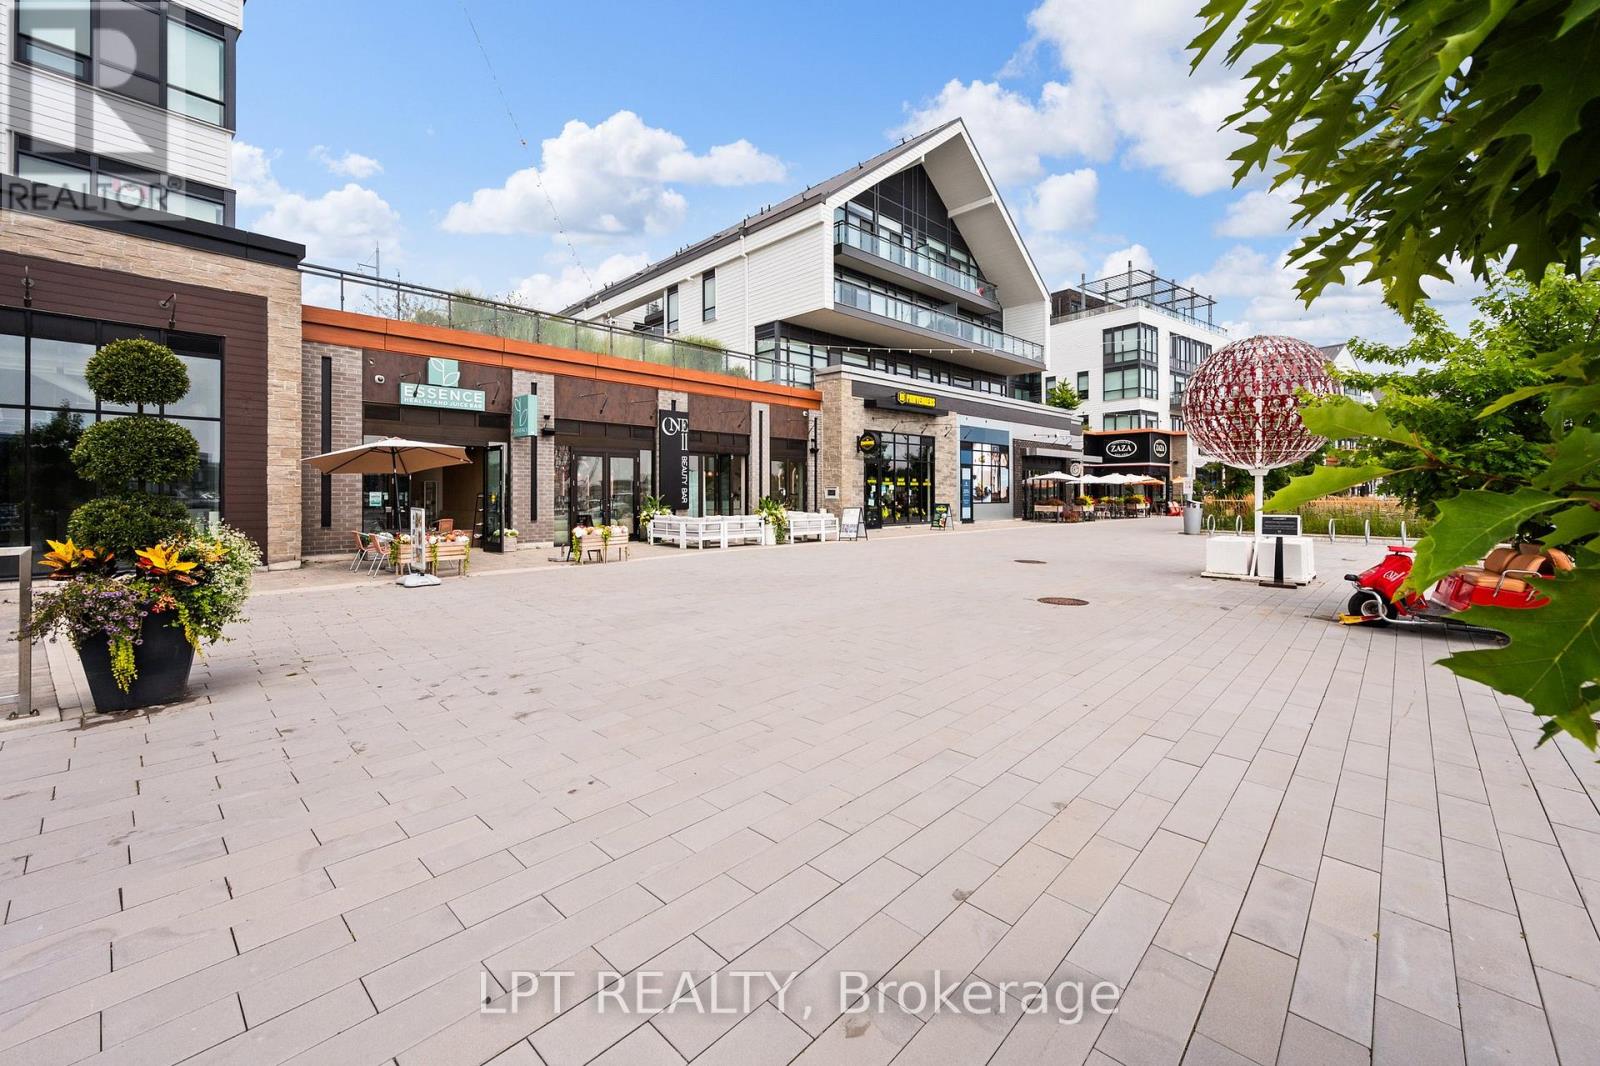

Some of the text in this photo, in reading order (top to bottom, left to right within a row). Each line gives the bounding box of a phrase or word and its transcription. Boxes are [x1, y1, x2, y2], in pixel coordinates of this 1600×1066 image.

[404, 385, 482, 403] ESSENCE
[661, 416, 689, 436] ONE
[1110, 444, 1132, 452] ZAZA
